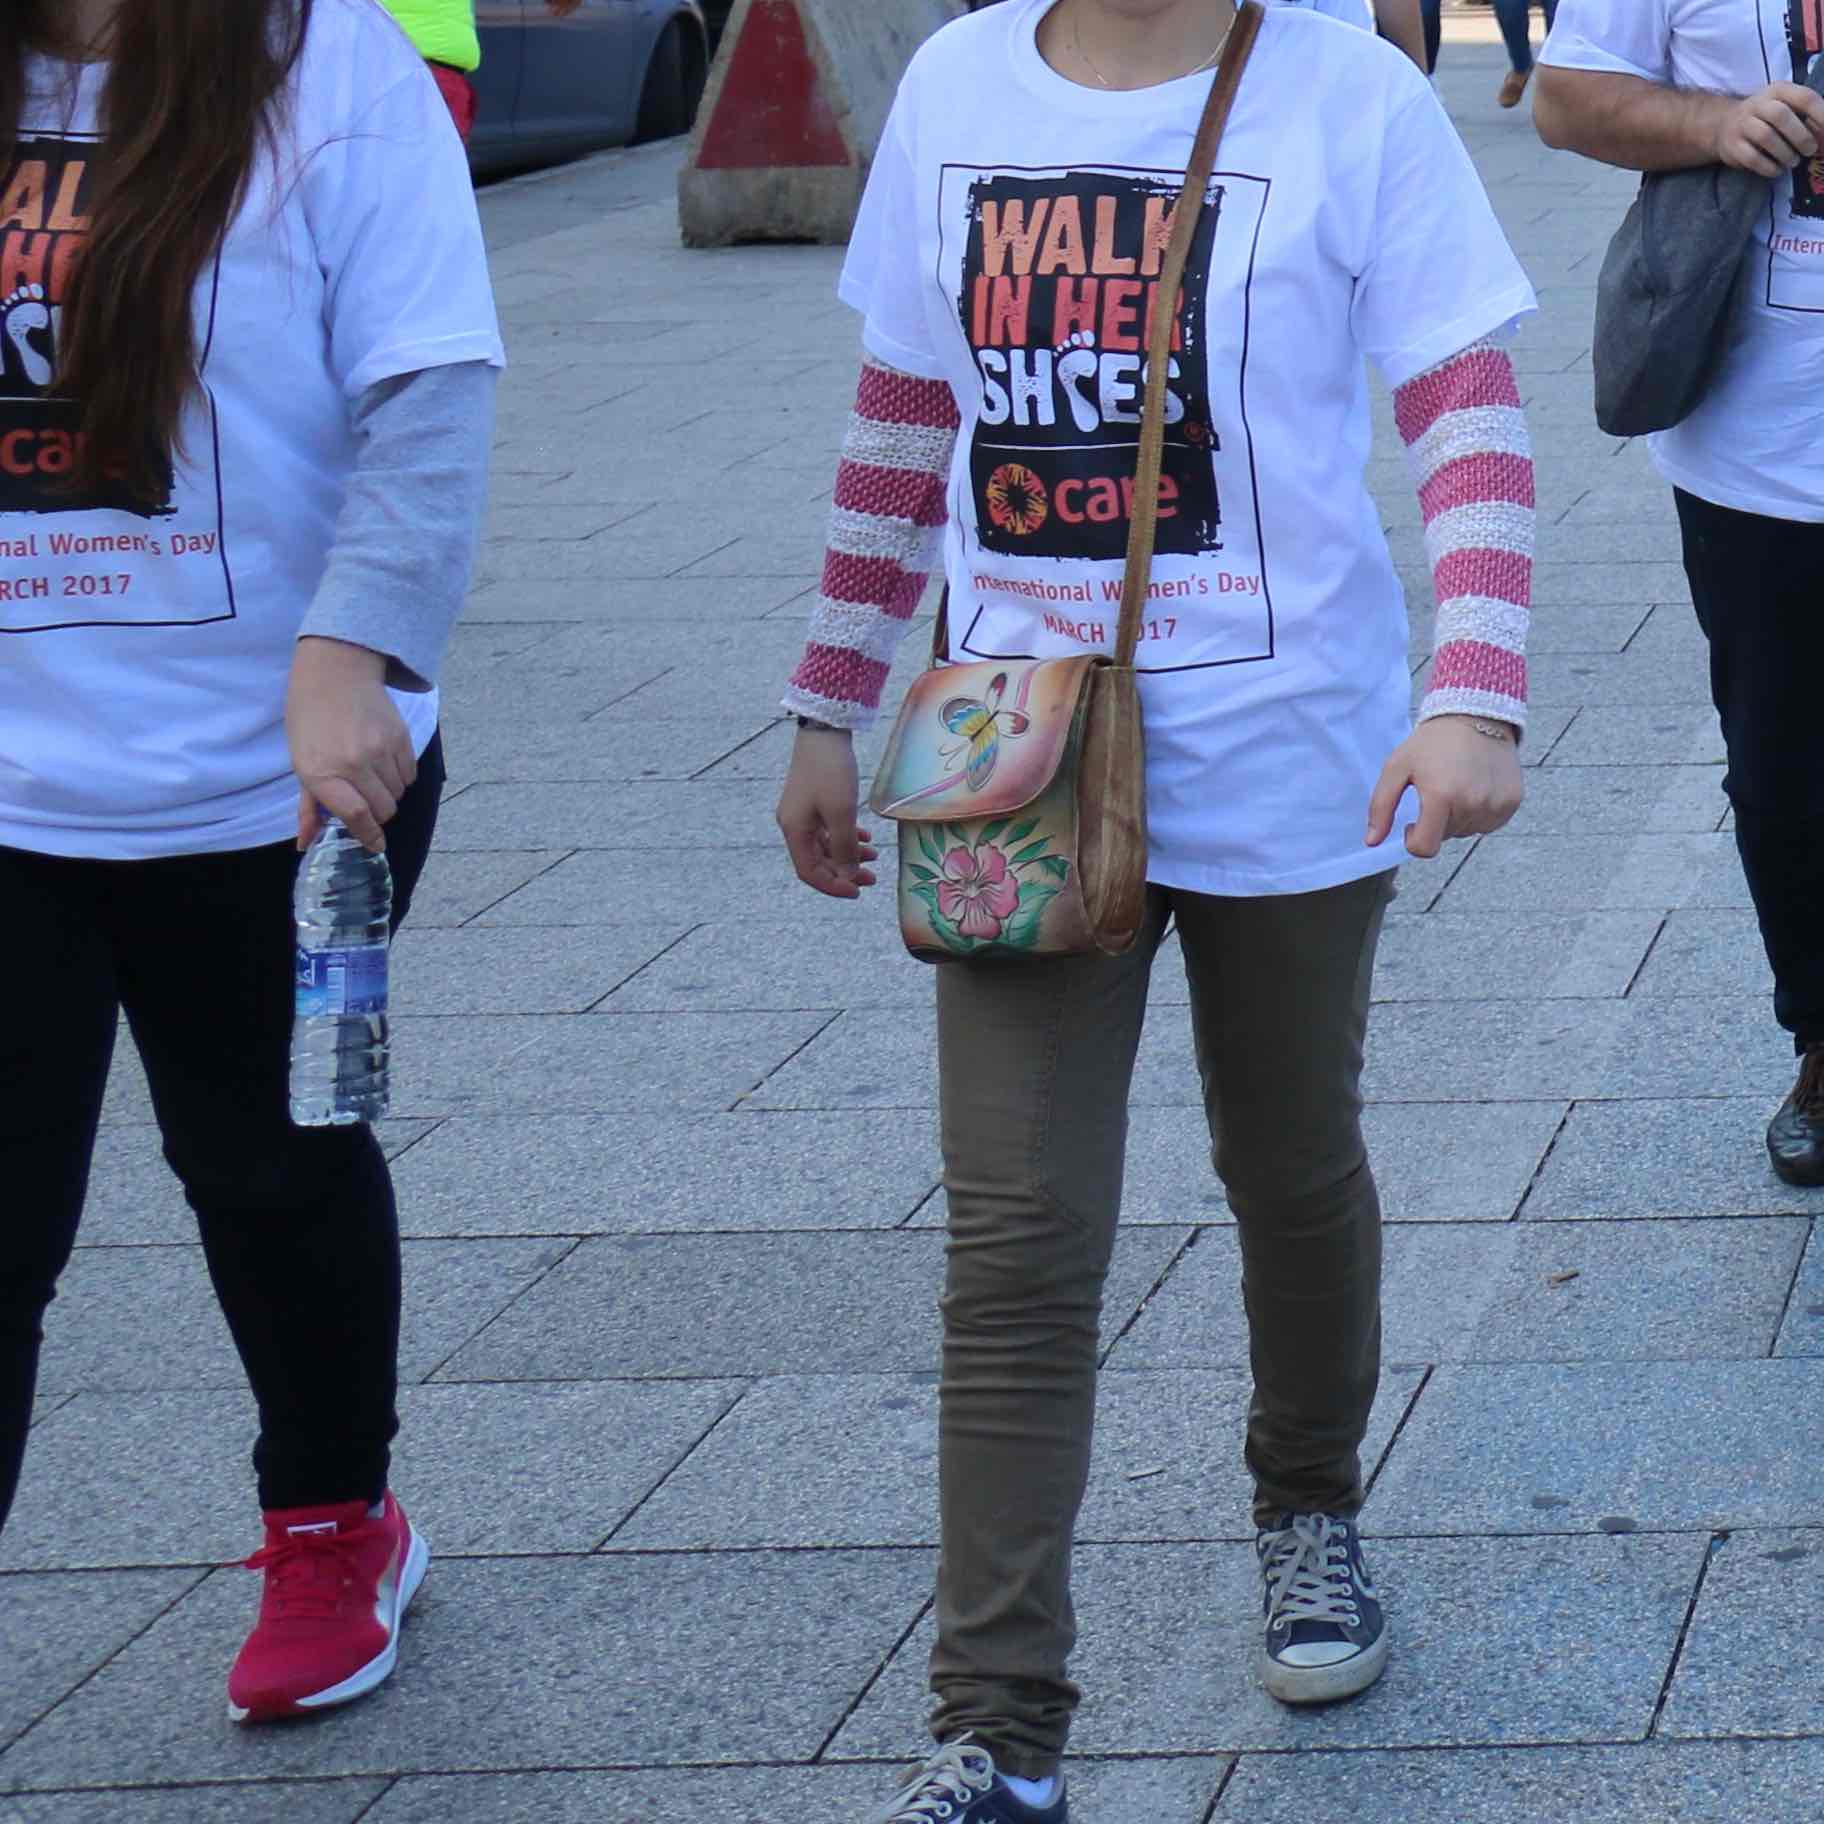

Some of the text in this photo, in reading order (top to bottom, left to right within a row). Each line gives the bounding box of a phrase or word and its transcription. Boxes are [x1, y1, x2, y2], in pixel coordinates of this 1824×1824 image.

[972, 273, 1033, 347] IN
[48, 532, 162, 558] Women's
[170, 531, 218, 557] Day
[62, 574, 132, 597] 2017
[1217, 572, 1261, 596] Day
[1042, 612, 1105, 643] MARCH
